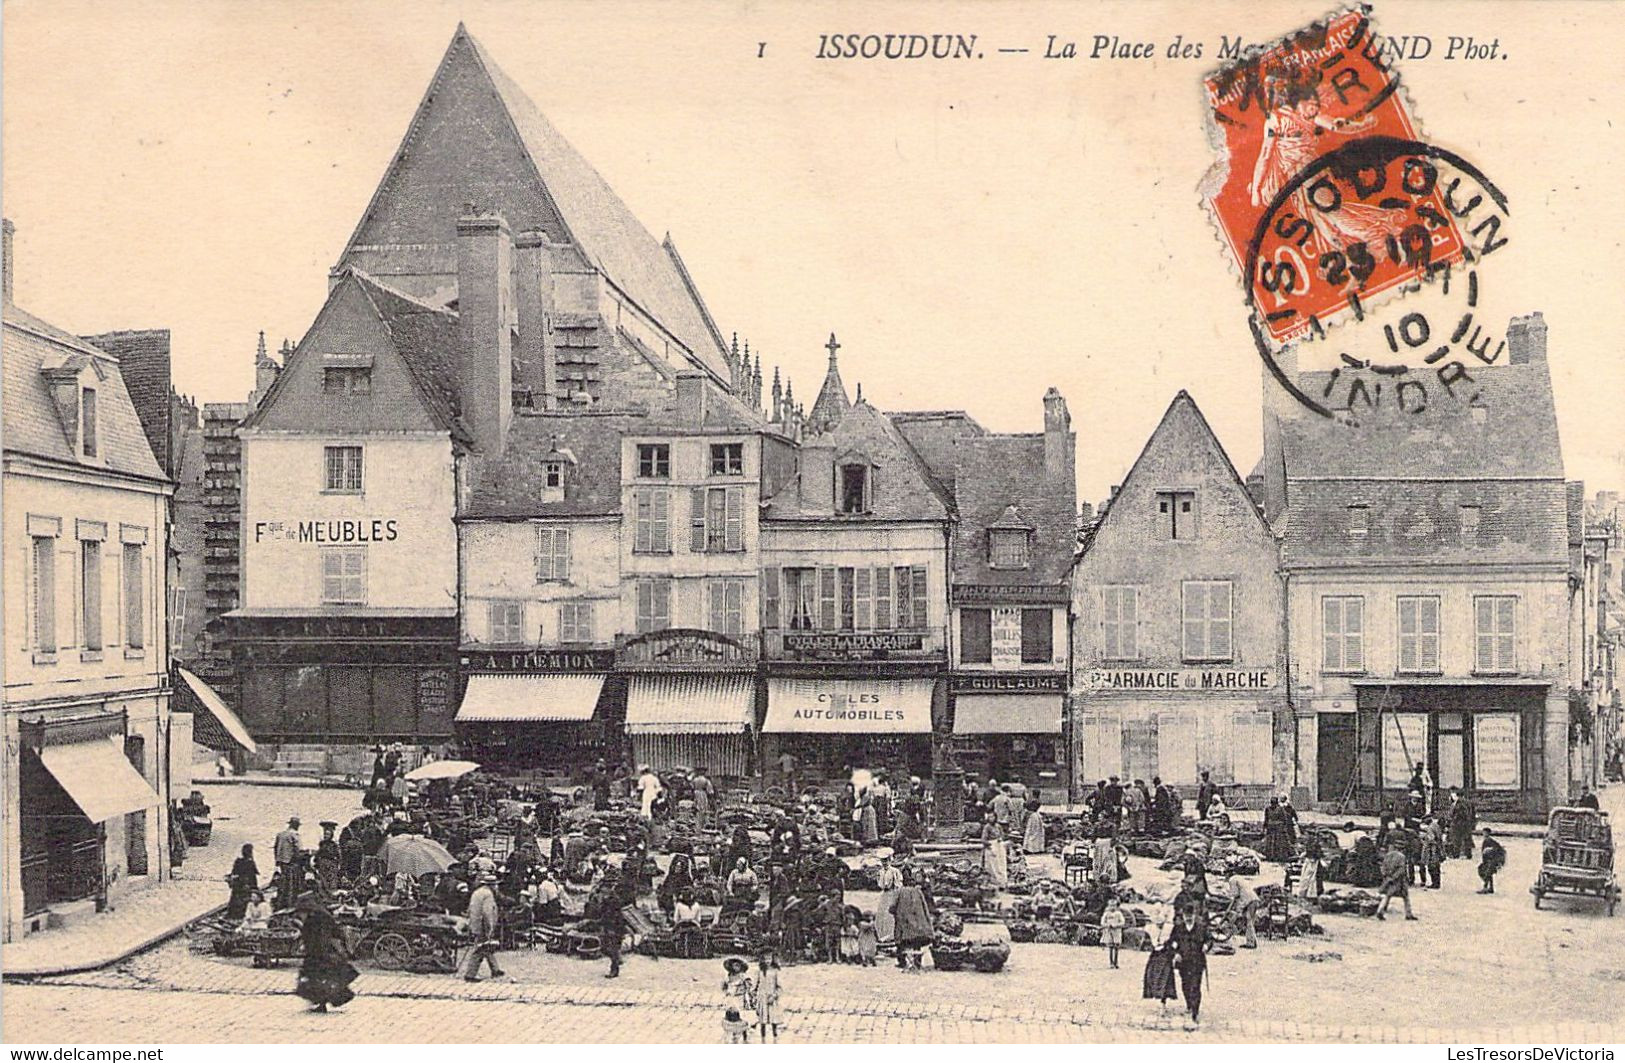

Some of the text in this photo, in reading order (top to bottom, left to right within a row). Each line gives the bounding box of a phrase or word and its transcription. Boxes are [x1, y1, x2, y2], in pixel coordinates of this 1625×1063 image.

[815, 35, 984, 59] ISSOUDUN.
[1043, 35, 1077, 59] La
[1090, 35, 1155, 59] Place
[1166, 35, 1204, 59] des
[1444, 36, 1508, 60] Phot.
[298, 519, 398, 543] MEUBLES
[971, 678, 1061, 689] GUILLAUME
[1091, 672, 1179, 689] PHARMACIE
[1184, 674, 1197, 688] du
[793, 709, 905, 720] AUTOMOBILES
